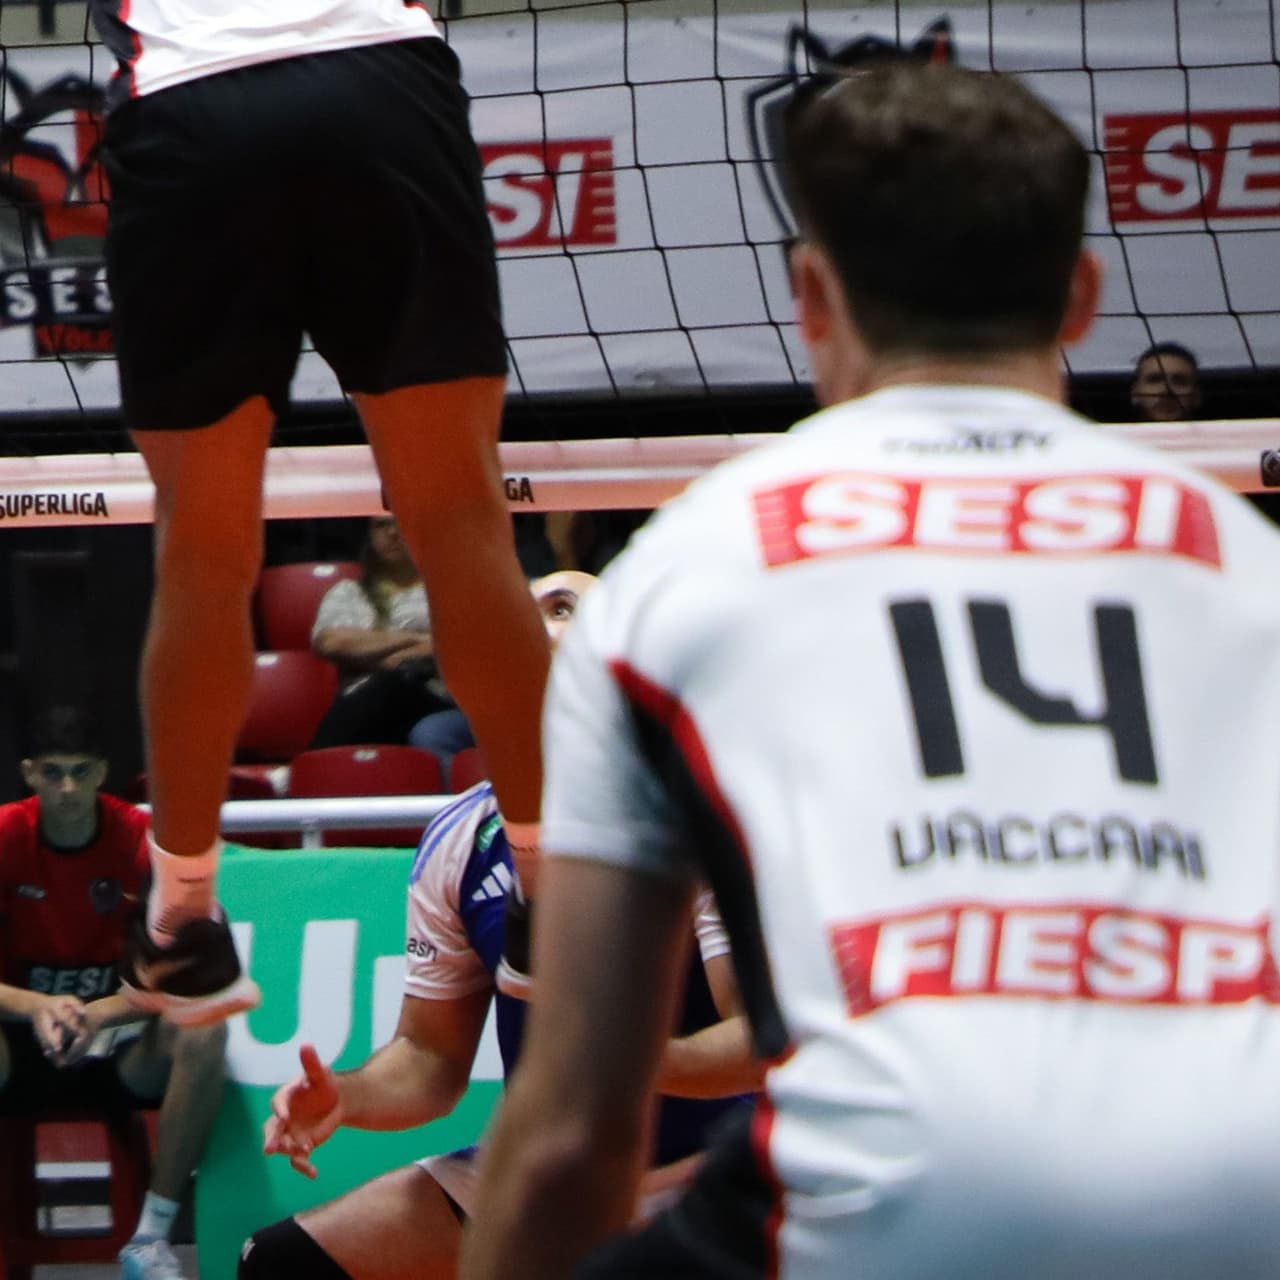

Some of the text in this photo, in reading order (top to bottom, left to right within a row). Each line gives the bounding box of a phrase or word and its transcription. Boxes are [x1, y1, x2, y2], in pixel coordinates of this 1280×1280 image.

[792, 472, 1182, 553] SESI
[887, 596, 1160, 787] 14
[868, 908, 1268, 1004] FIESP
